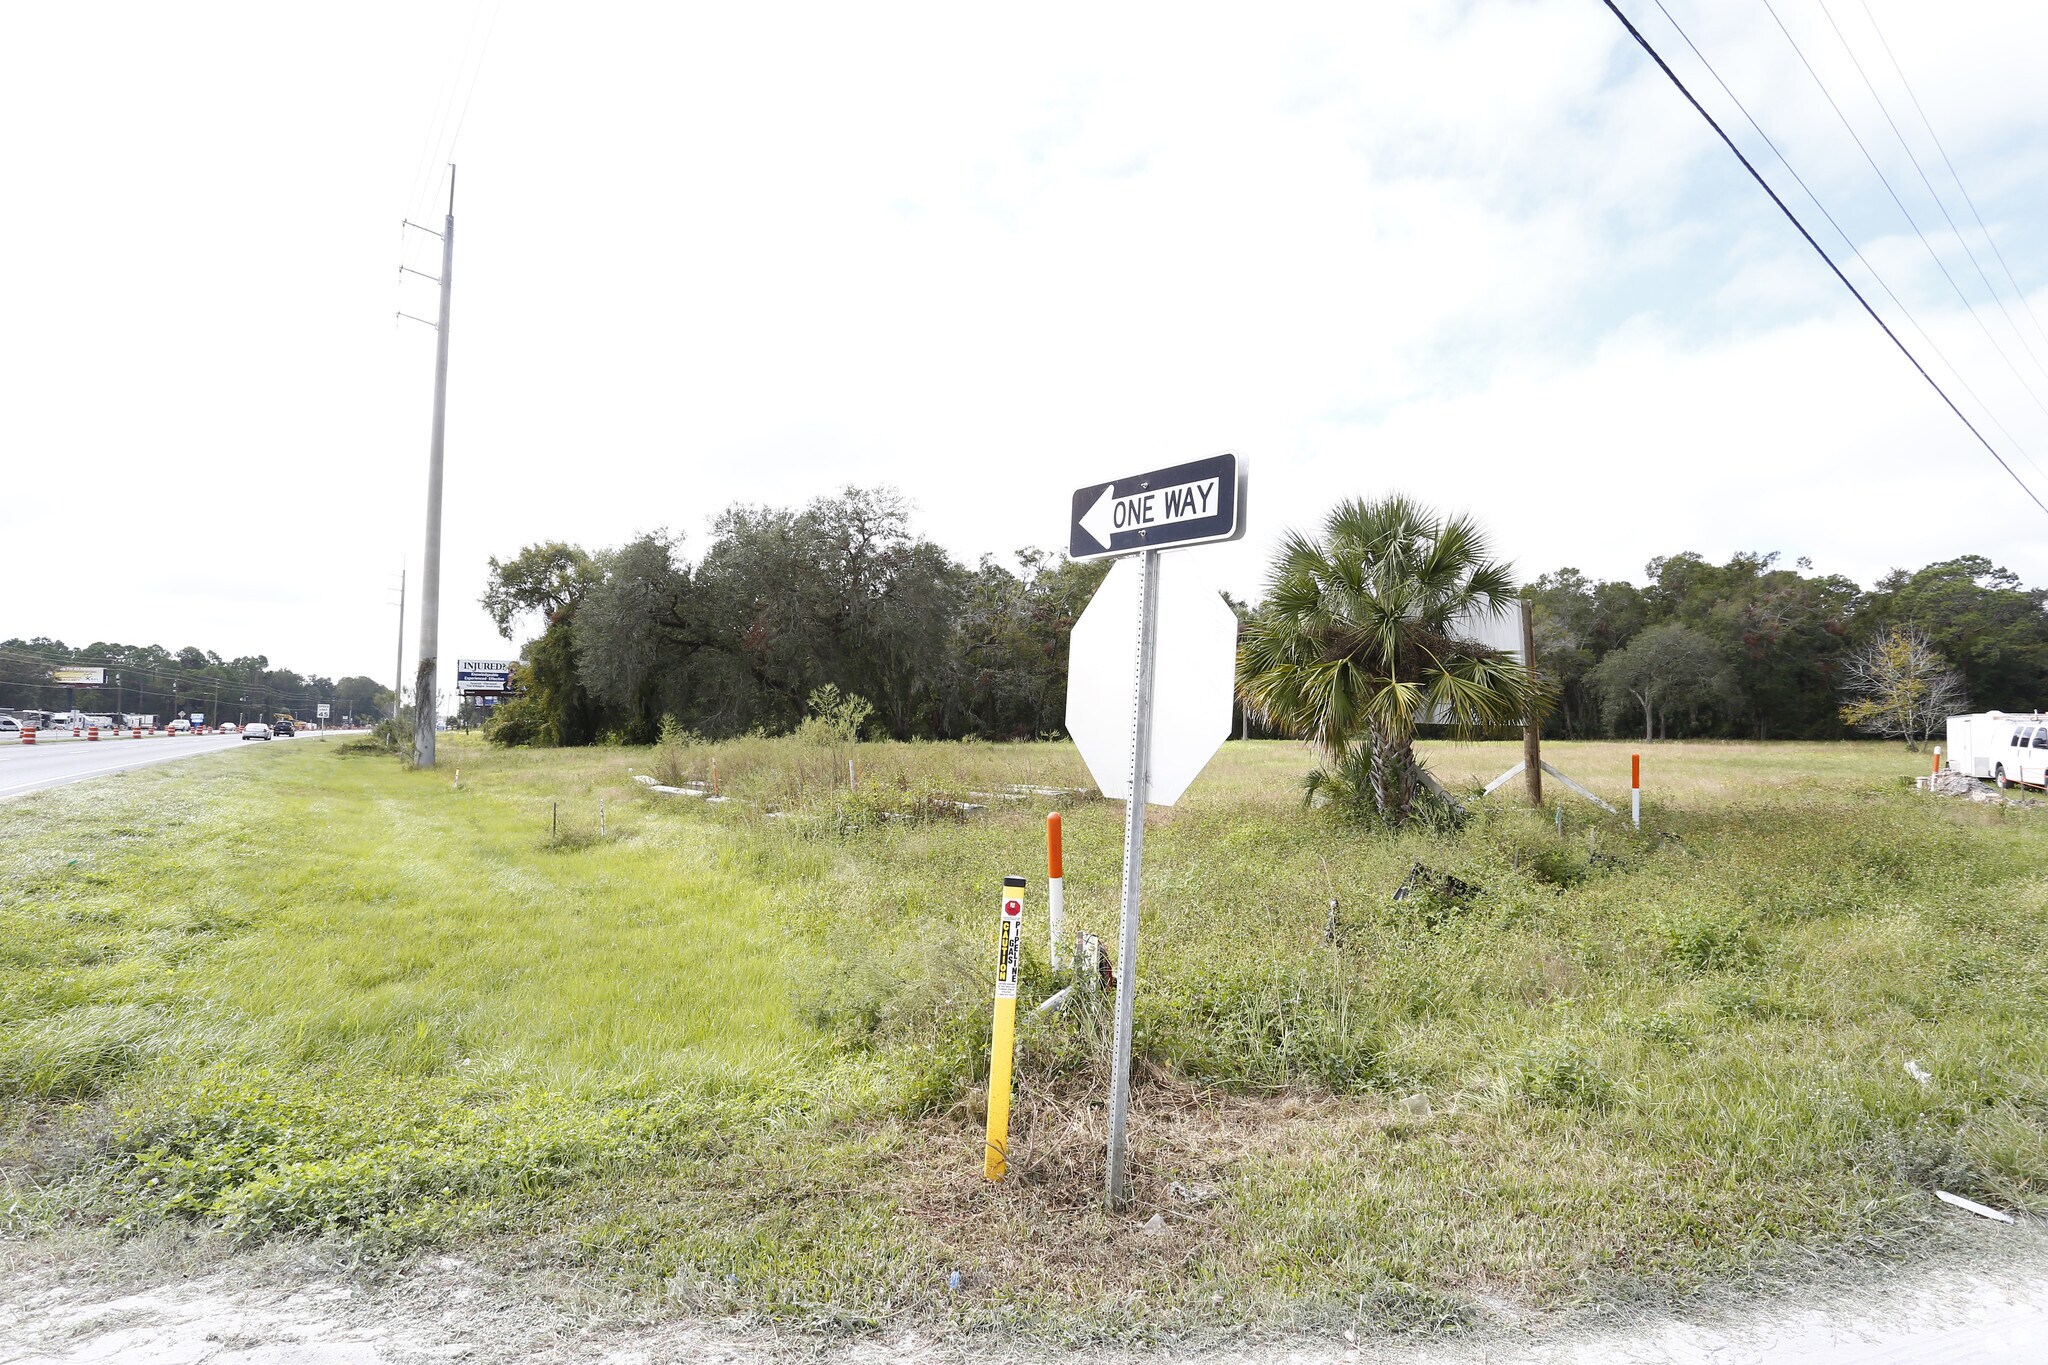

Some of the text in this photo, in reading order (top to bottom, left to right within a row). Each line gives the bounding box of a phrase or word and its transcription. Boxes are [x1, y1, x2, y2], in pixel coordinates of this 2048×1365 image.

[1113, 482, 1214, 528] ONE WAY
[464, 662, 506, 671] INJURED?
[1000, 922, 1009, 980] CAUTION
[1012, 921, 1020, 982] PIPELINE
